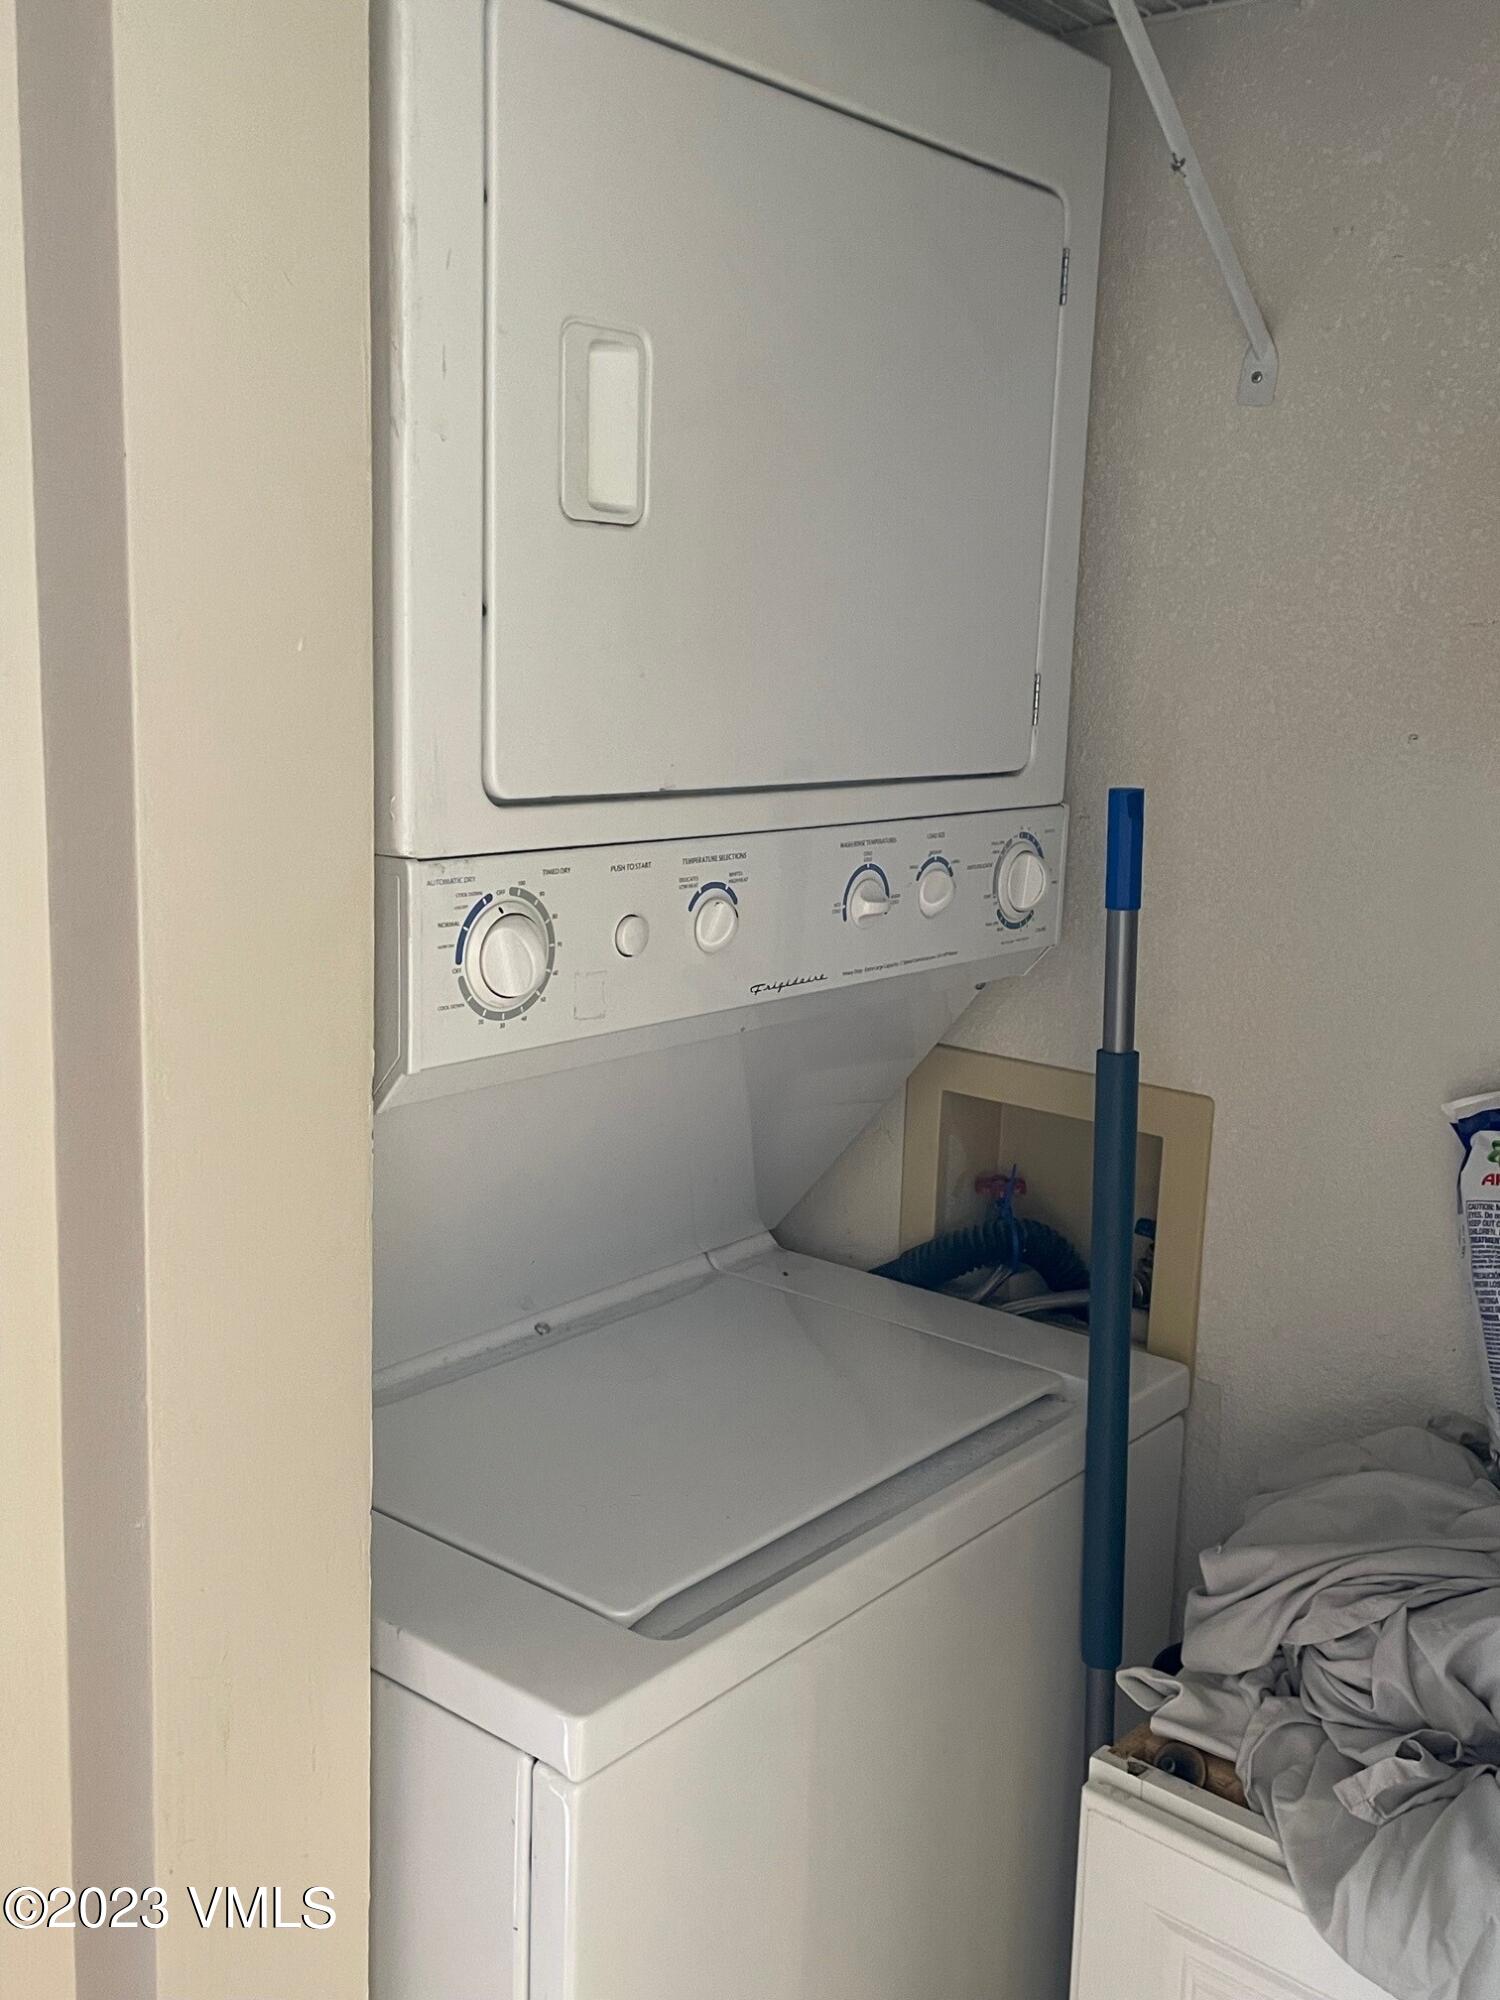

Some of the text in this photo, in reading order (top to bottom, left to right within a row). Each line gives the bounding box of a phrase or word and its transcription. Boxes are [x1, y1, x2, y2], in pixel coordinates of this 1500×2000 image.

[682, 852, 748, 864] TEMPERATURE SELECTIONS
[610, 864, 626, 872] PUSH
[635, 862, 652, 870] START
[426, 876, 462, 886] AUTOMATIC
[750, 974, 828, 996] Frigidaire
